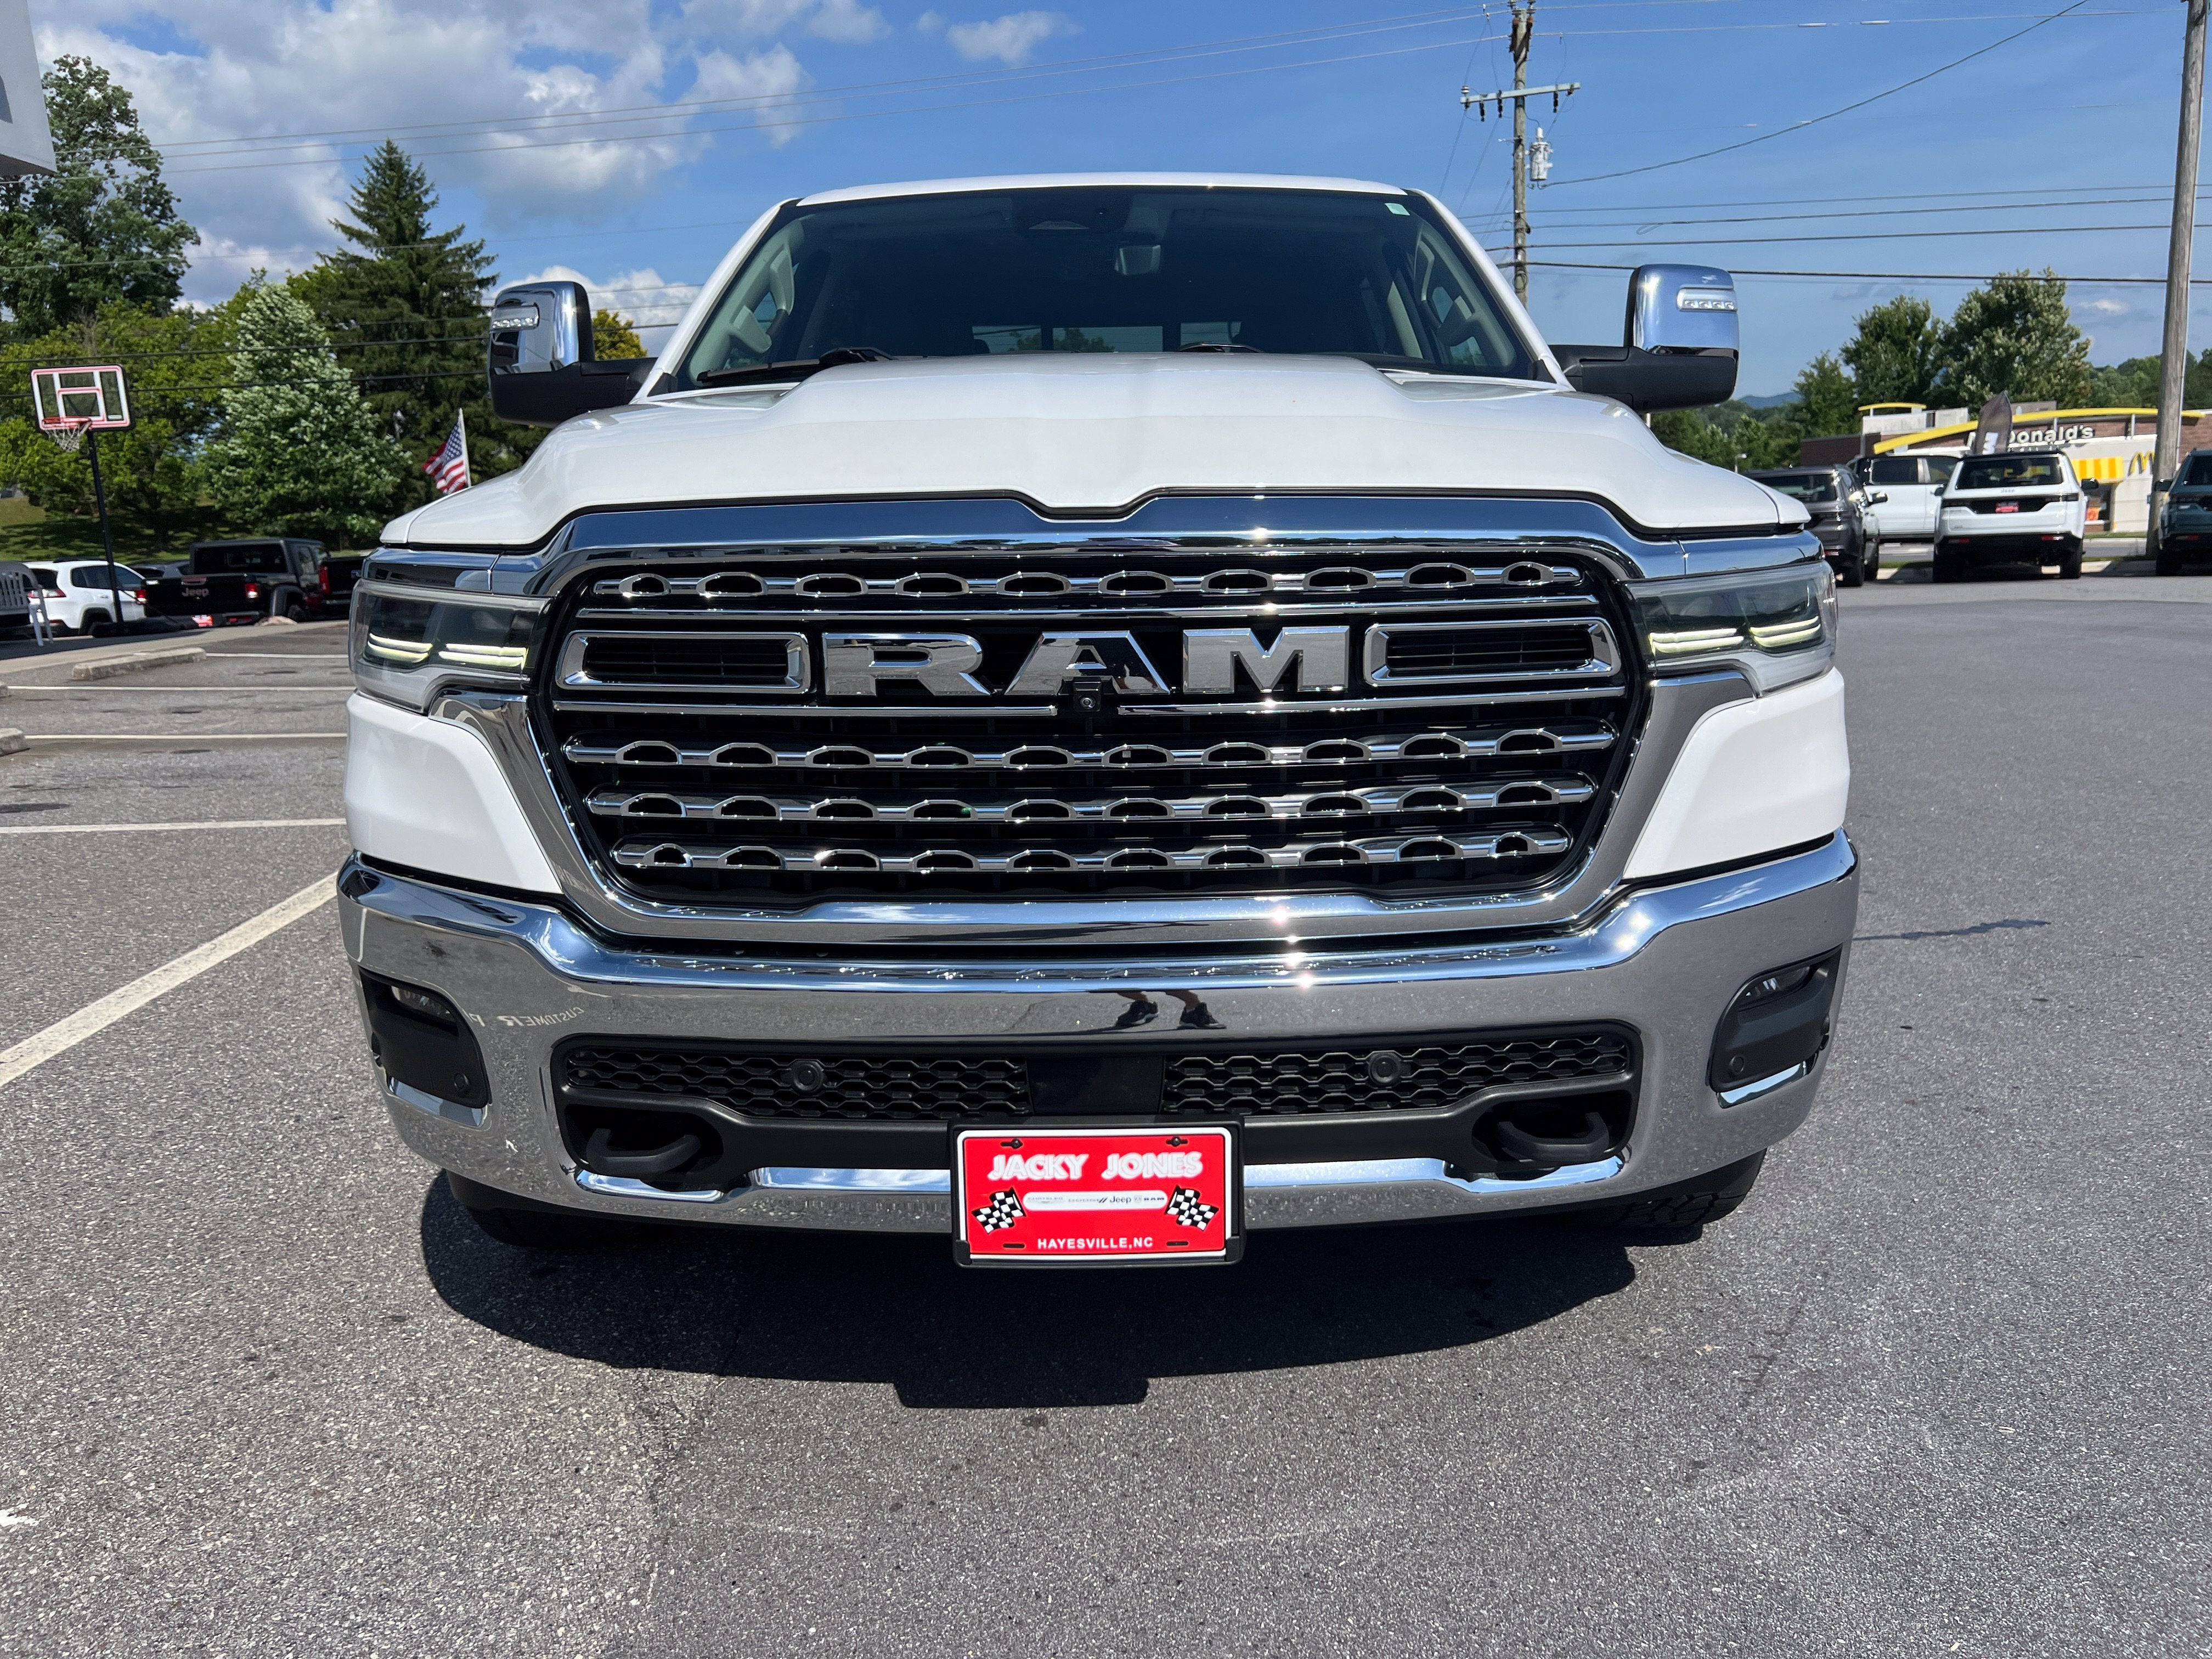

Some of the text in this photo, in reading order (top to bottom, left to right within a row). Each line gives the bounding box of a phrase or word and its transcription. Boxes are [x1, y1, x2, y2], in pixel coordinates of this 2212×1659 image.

[182, 588, 210, 597] Jeep
[822, 625, 1350, 696] RAM
[987, 1152, 1203, 1180] JACKY JONES
[1110, 1195, 1131, 1204] Jeep
[1037, 1237, 1154, 1249] HAYESVILLE,NC
